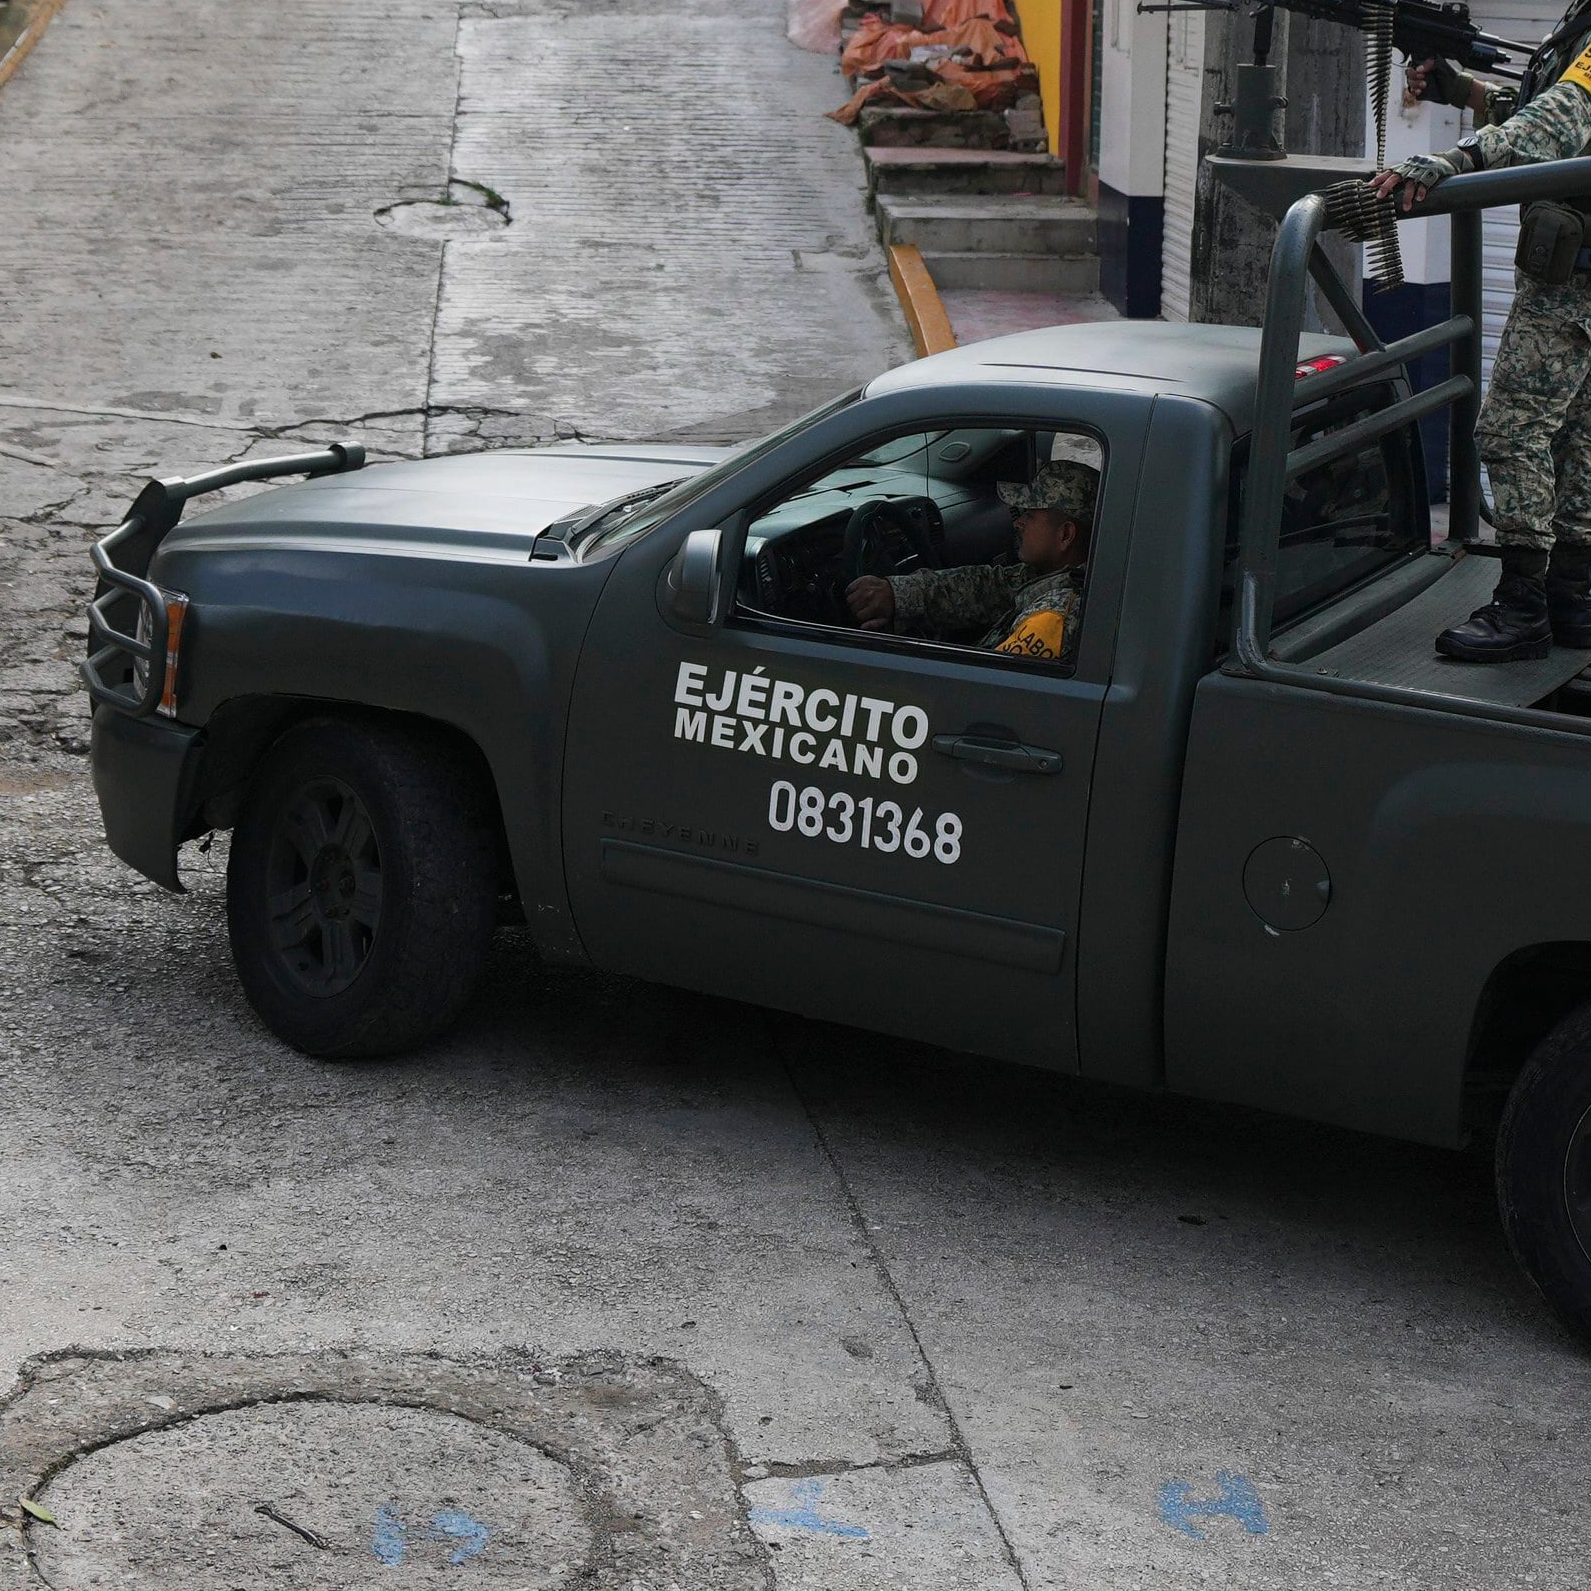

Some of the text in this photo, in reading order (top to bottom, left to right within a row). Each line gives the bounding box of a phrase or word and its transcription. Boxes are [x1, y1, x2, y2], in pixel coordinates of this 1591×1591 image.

[1016, 624, 1058, 660] LABO
[674, 661, 929, 750] EJÉRCITO
[674, 707, 918, 785] MEXICANO
[768, 780, 963, 864] 0831368
